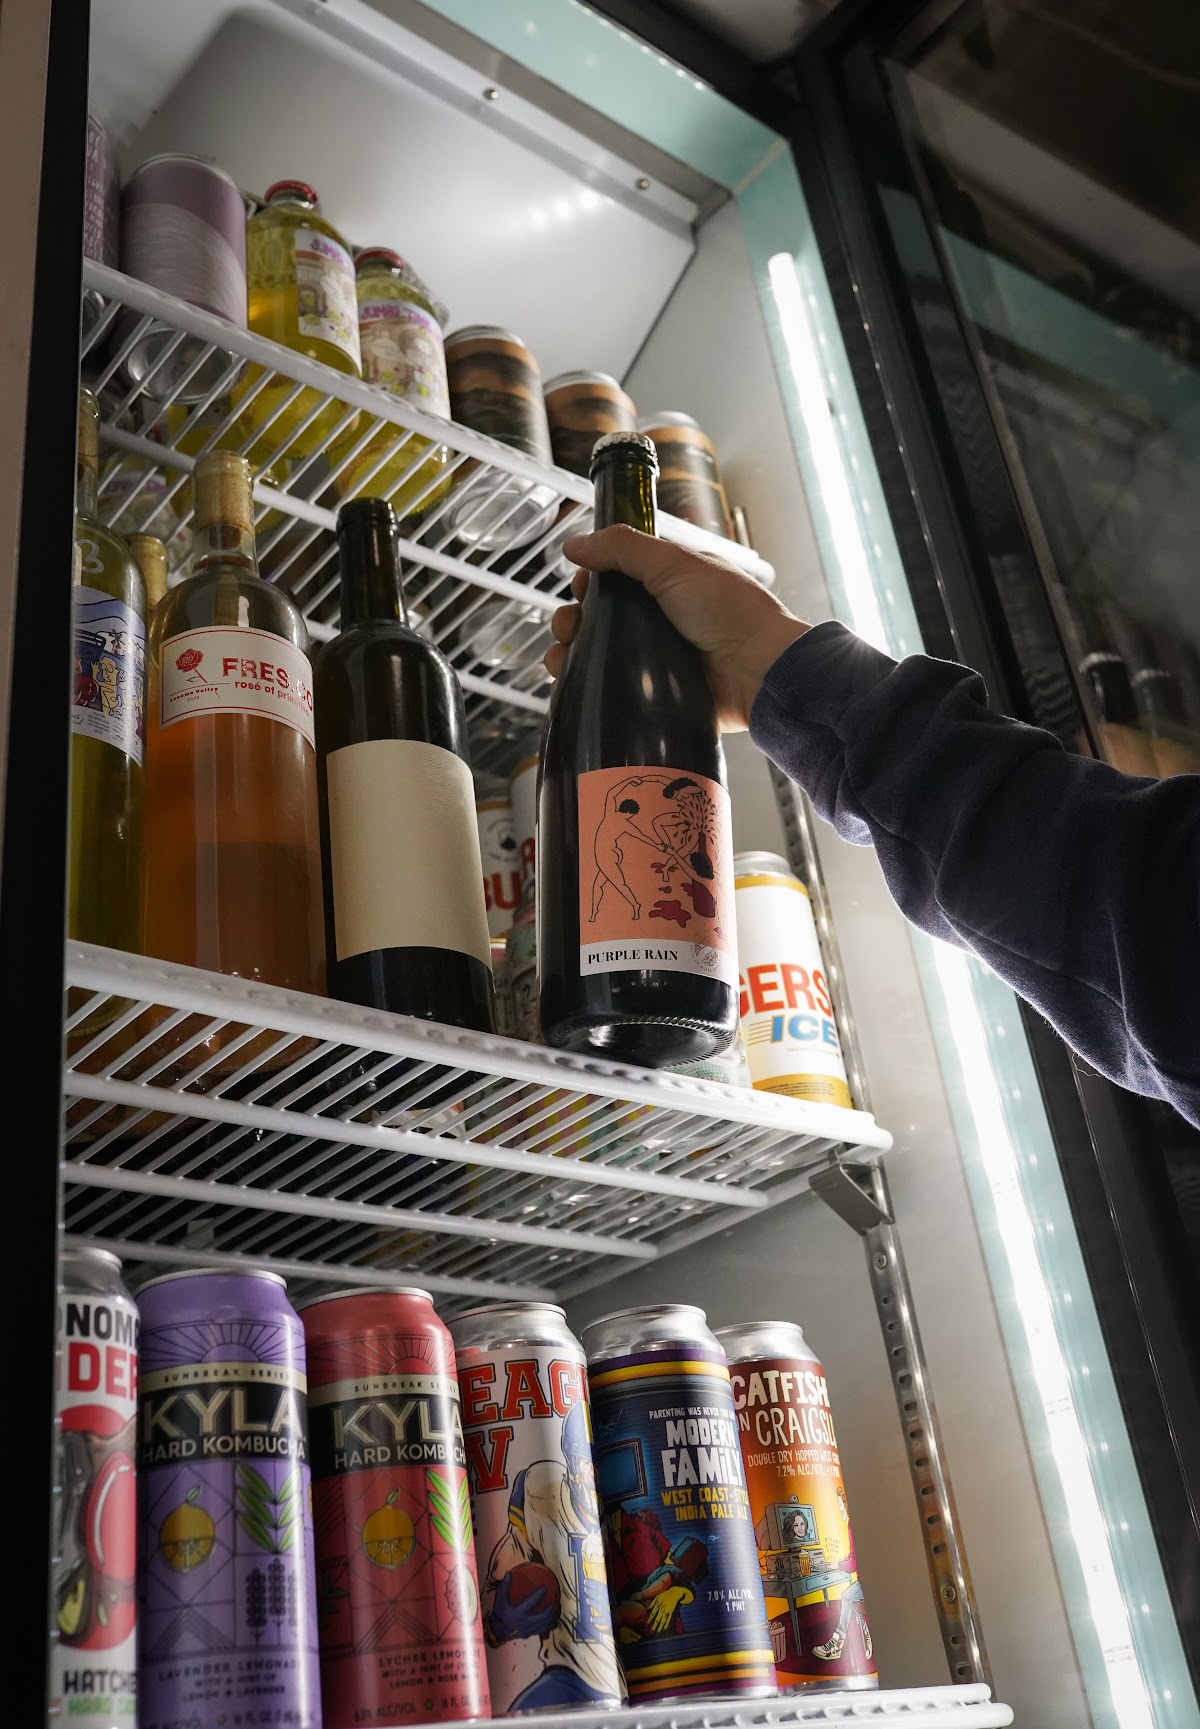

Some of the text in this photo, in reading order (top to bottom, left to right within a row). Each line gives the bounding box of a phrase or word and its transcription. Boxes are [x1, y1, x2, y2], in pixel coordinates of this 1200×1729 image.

[234, 680, 261, 691] rosé
[264, 686, 275, 695] of
[588, 950, 640, 965] PURPLE
[645, 949, 679, 961] RAIN
[770, 1014, 838, 1048] ICE
[164, 1368, 241, 1383] SUNBREAK
[354, 1381, 423, 1393] SUNBREAK
[731, 1369, 831, 1411] CATFISH
[143, 1387, 304, 1442] KYLA
[687, 1406, 702, 1416] WAS
[332, 1399, 466, 1450] KYLA
[735, 1411, 751, 1432] N
[665, 1418, 737, 1448] MODERN
[143, 1435, 306, 1463] HARD KOMBUCHA
[334, 1446, 391, 1470] HARD
[747, 1452, 776, 1468] DOUBLE
[777, 1450, 793, 1463] DRY
[776, 1464, 796, 1478] 7.2%
[661, 1488, 693, 1506] WEST
[711, 1503, 734, 1520] PALE
[725, 1601, 730, 1612] 1
[379, 1653, 427, 1668] LYCHEE
[389, 1678, 424, 1690] LEMON
